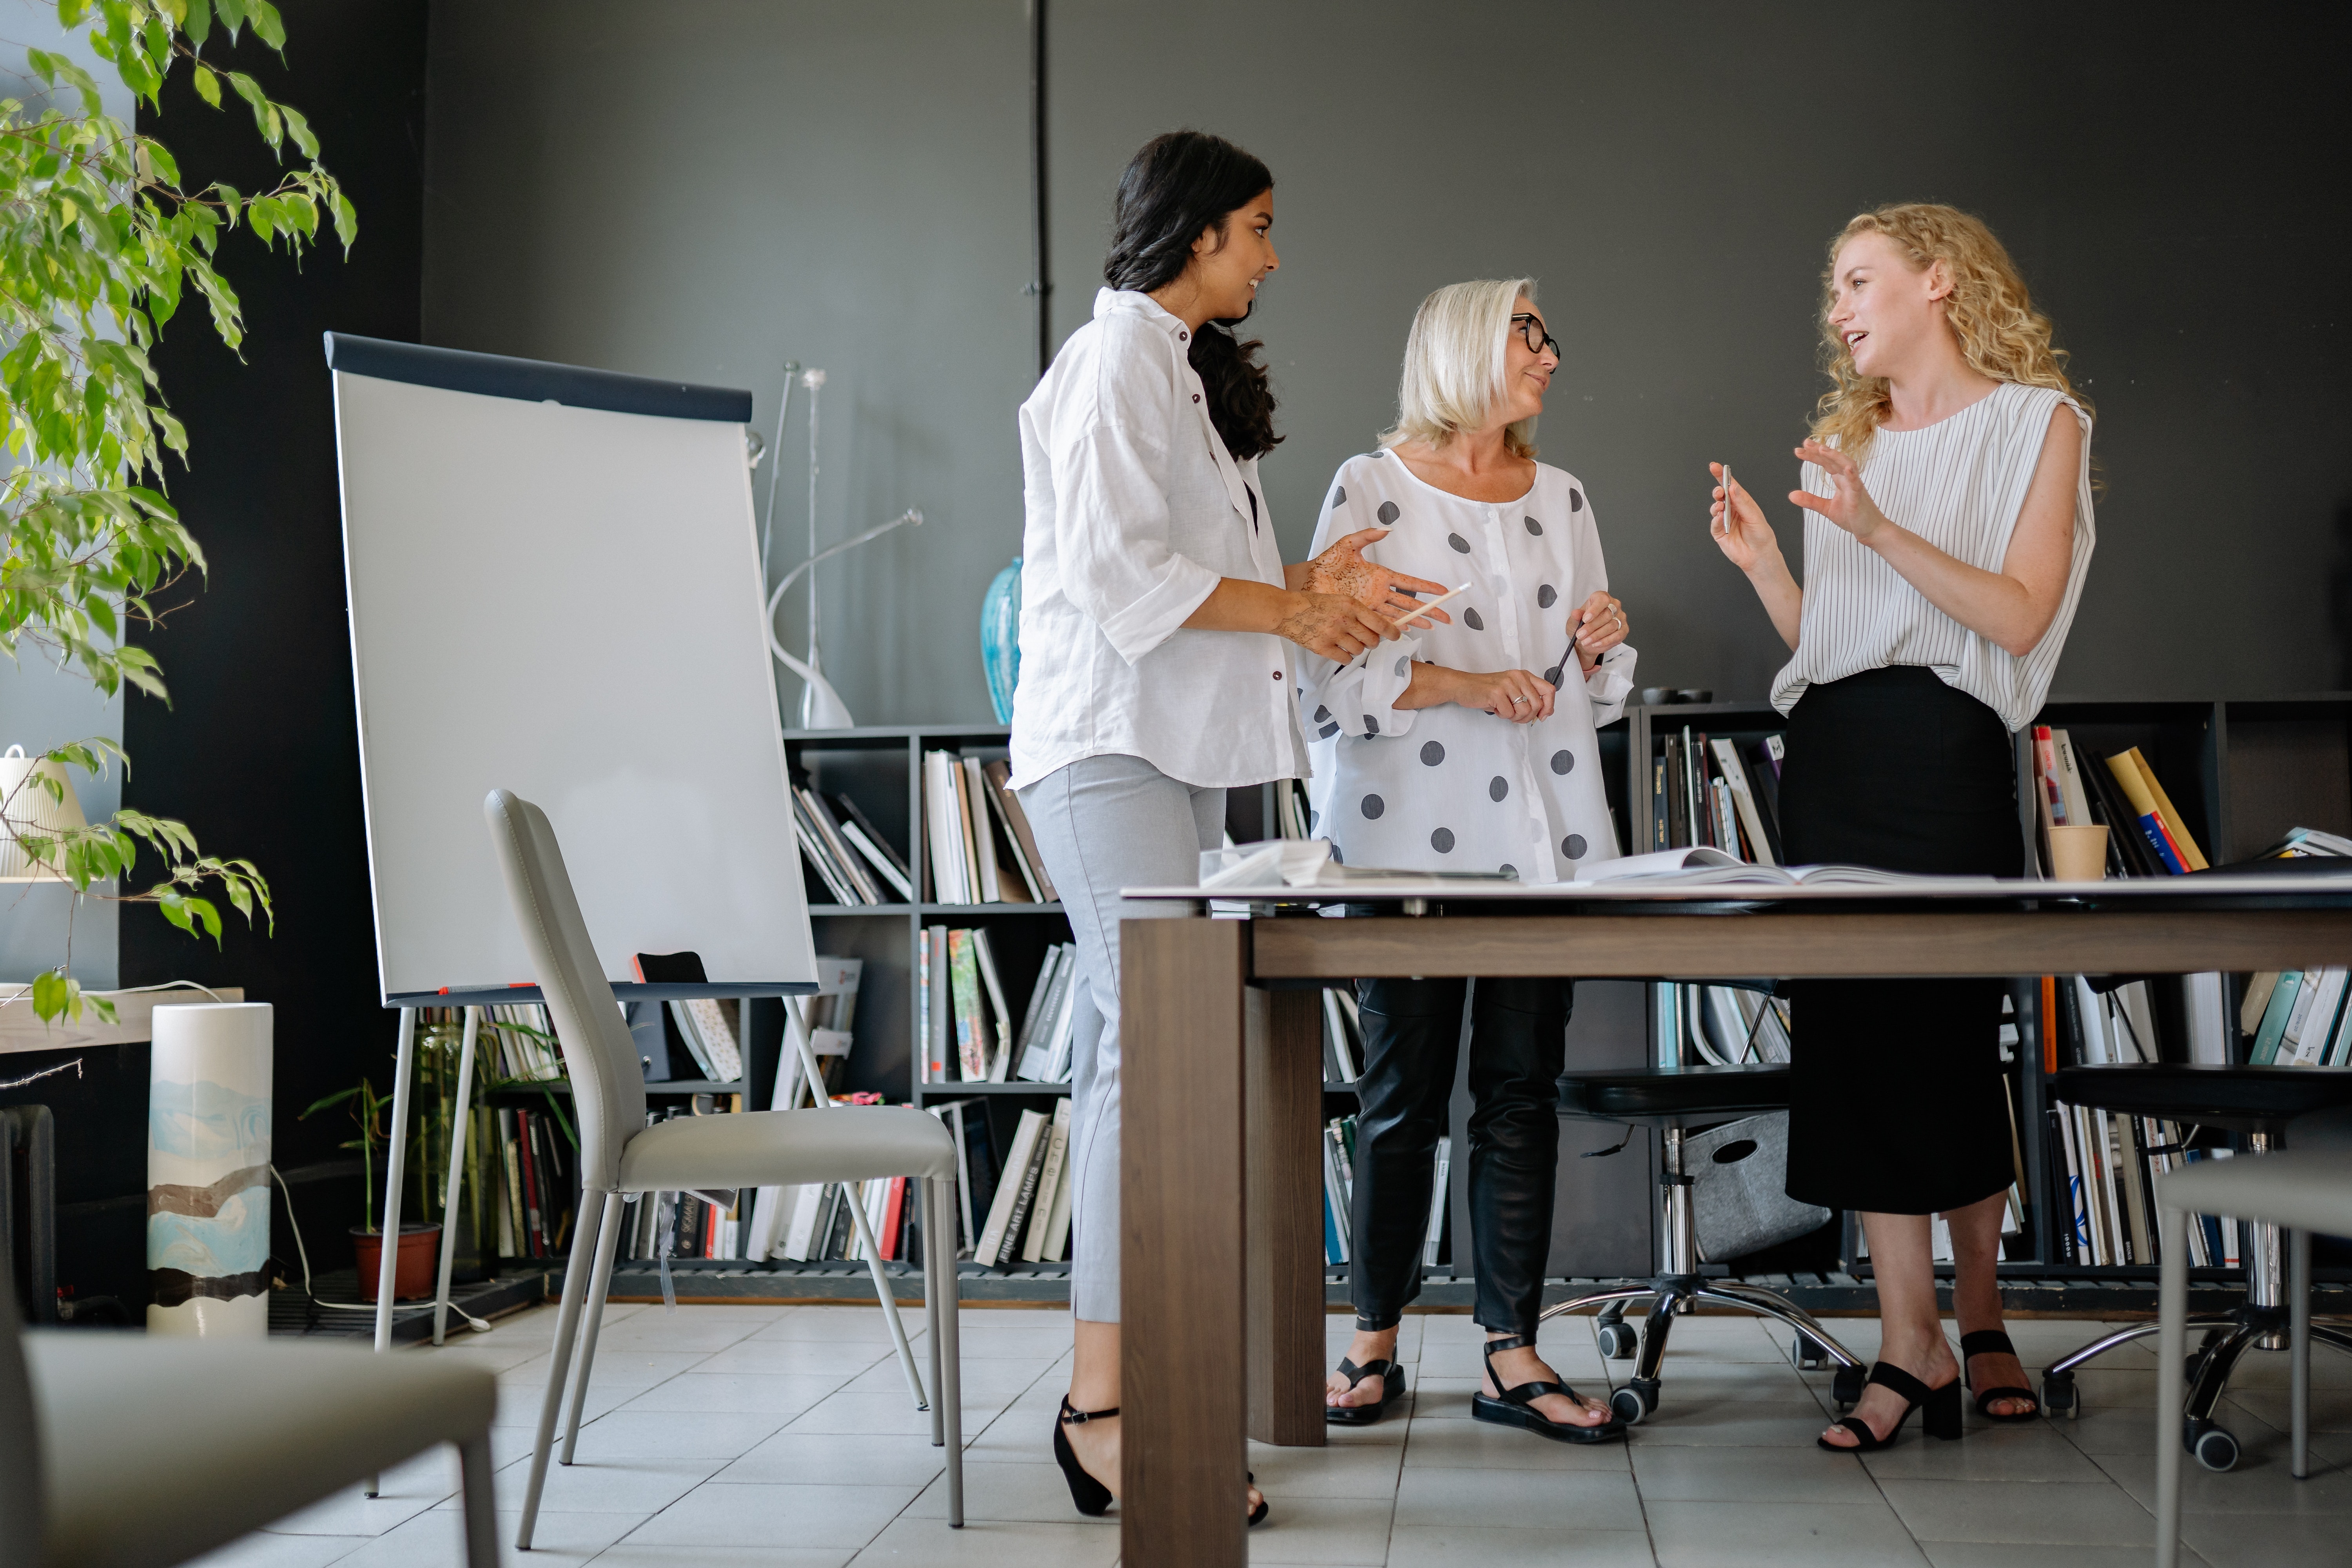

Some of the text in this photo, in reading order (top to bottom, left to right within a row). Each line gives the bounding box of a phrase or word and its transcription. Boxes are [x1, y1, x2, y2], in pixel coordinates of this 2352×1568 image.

[1001, 1233, 1015, 1260] FINE
[1009, 1208, 1024, 1230] ART
[1019, 1167, 1039, 1205] LAMPS
